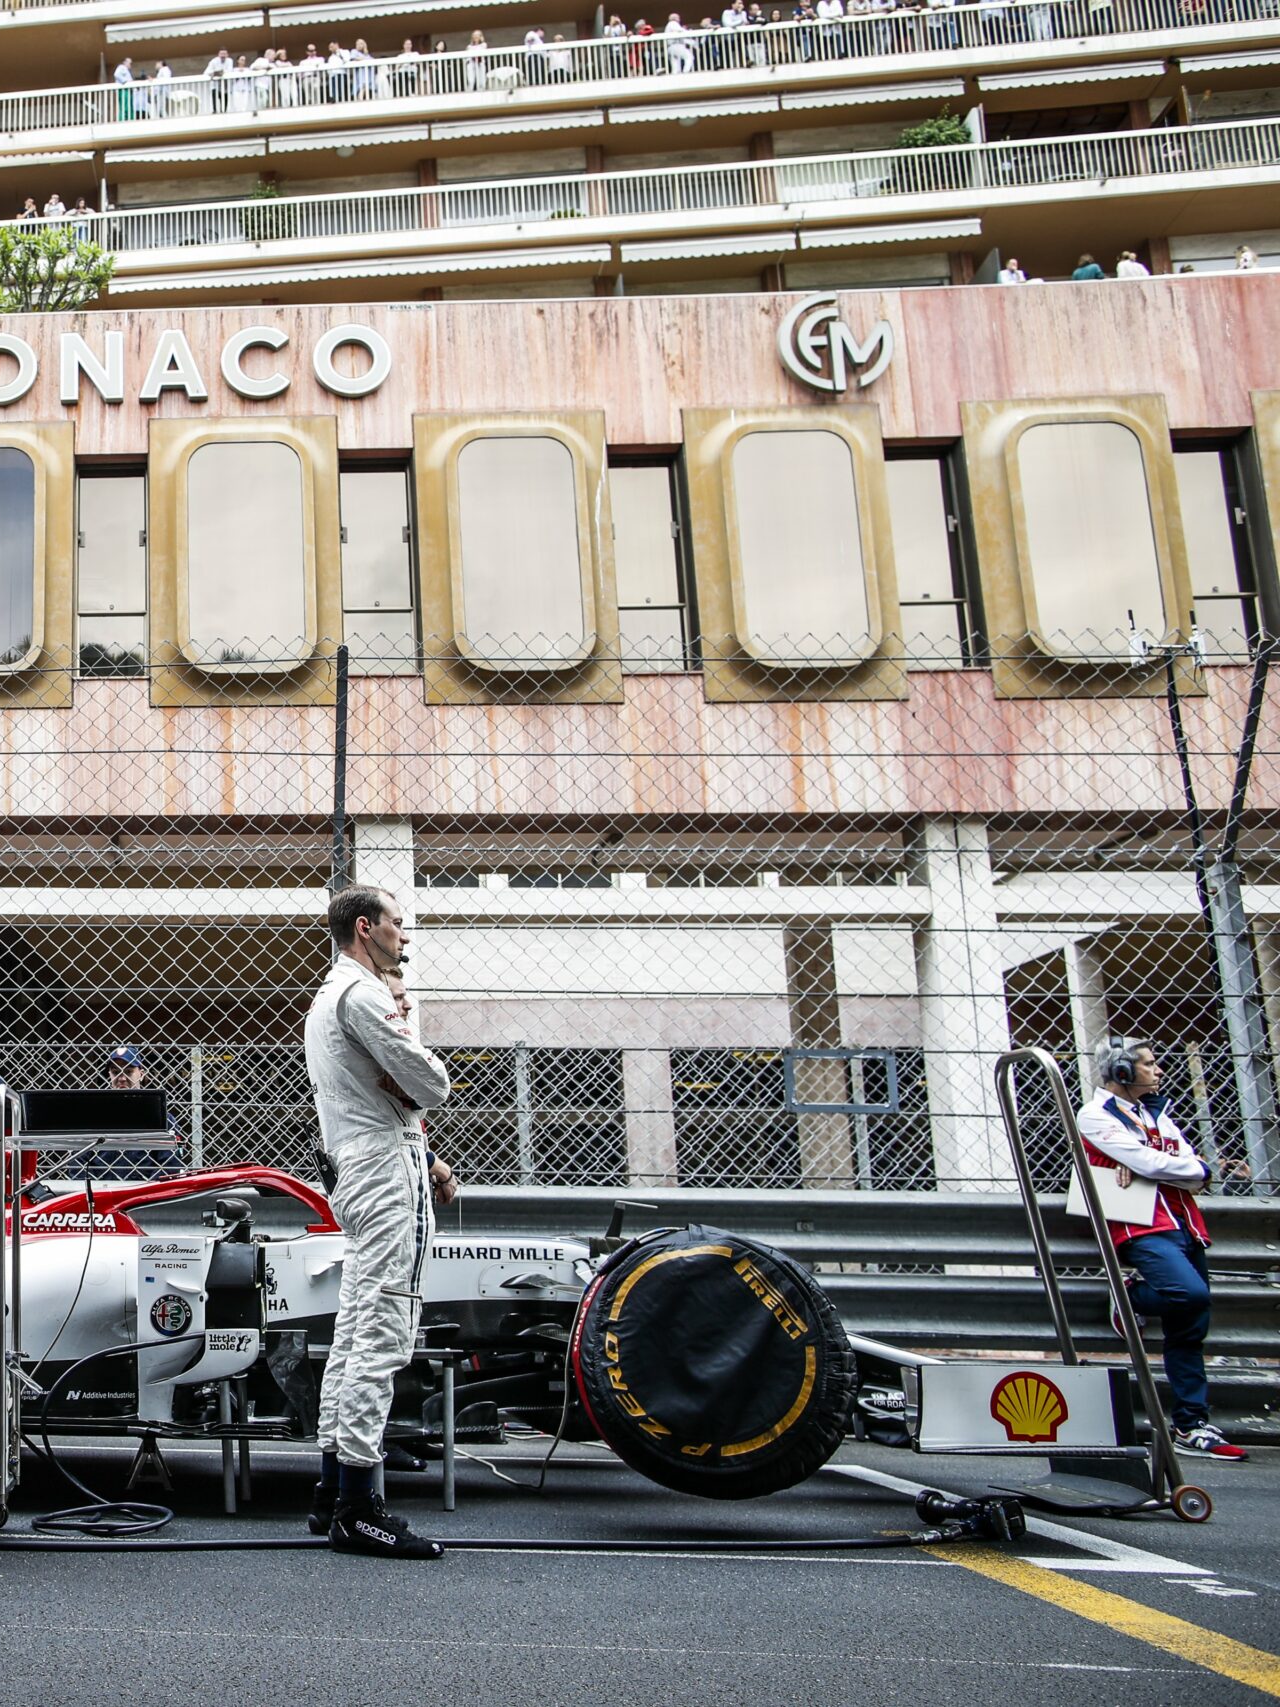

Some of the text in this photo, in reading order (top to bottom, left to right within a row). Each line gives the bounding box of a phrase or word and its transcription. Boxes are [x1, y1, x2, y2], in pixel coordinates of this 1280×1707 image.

[23, 1212, 116, 1227] CARRERA
[141, 1243, 200, 1256] Alfa Romeo
[508, 1247, 564, 1261] MILLE
[733, 1257, 808, 1341] PIRELLI
[209, 1334, 236, 1343] little
[209, 1343, 236, 1351] mole
[605, 1331, 673, 1441] ZERO
[82, 1391, 107, 1399] Additive
[107, 1390, 136, 1399] Industries
[887, 1400, 905, 1408] ROA
[355, 1520, 397, 1546] sparco
